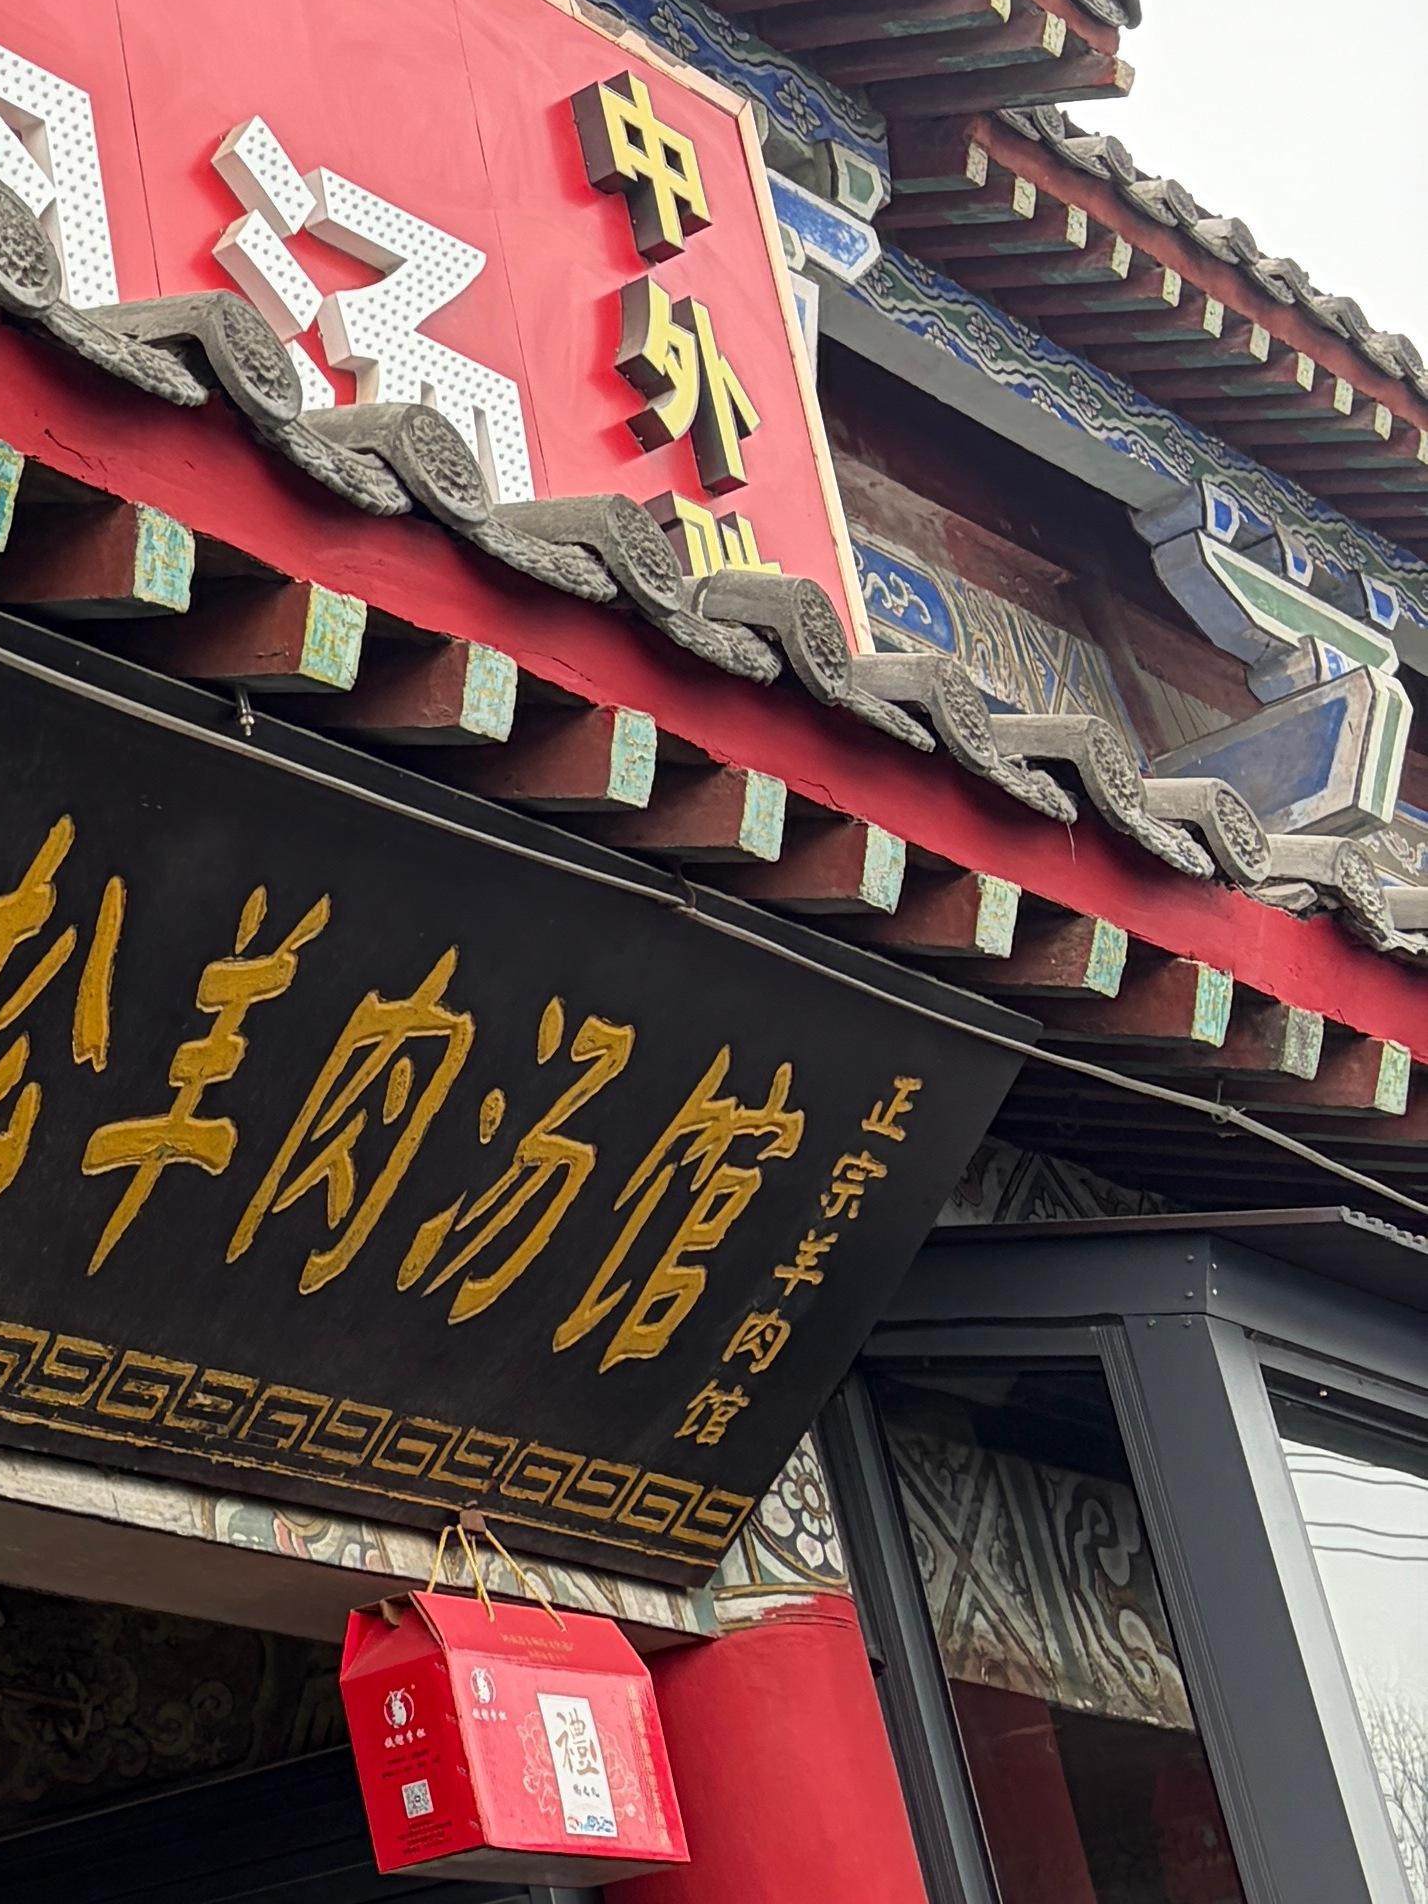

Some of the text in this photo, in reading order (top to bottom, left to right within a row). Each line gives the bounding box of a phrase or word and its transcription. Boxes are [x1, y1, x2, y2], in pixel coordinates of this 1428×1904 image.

[673, 1074, 924, 1448] 正宗羊肉馆
